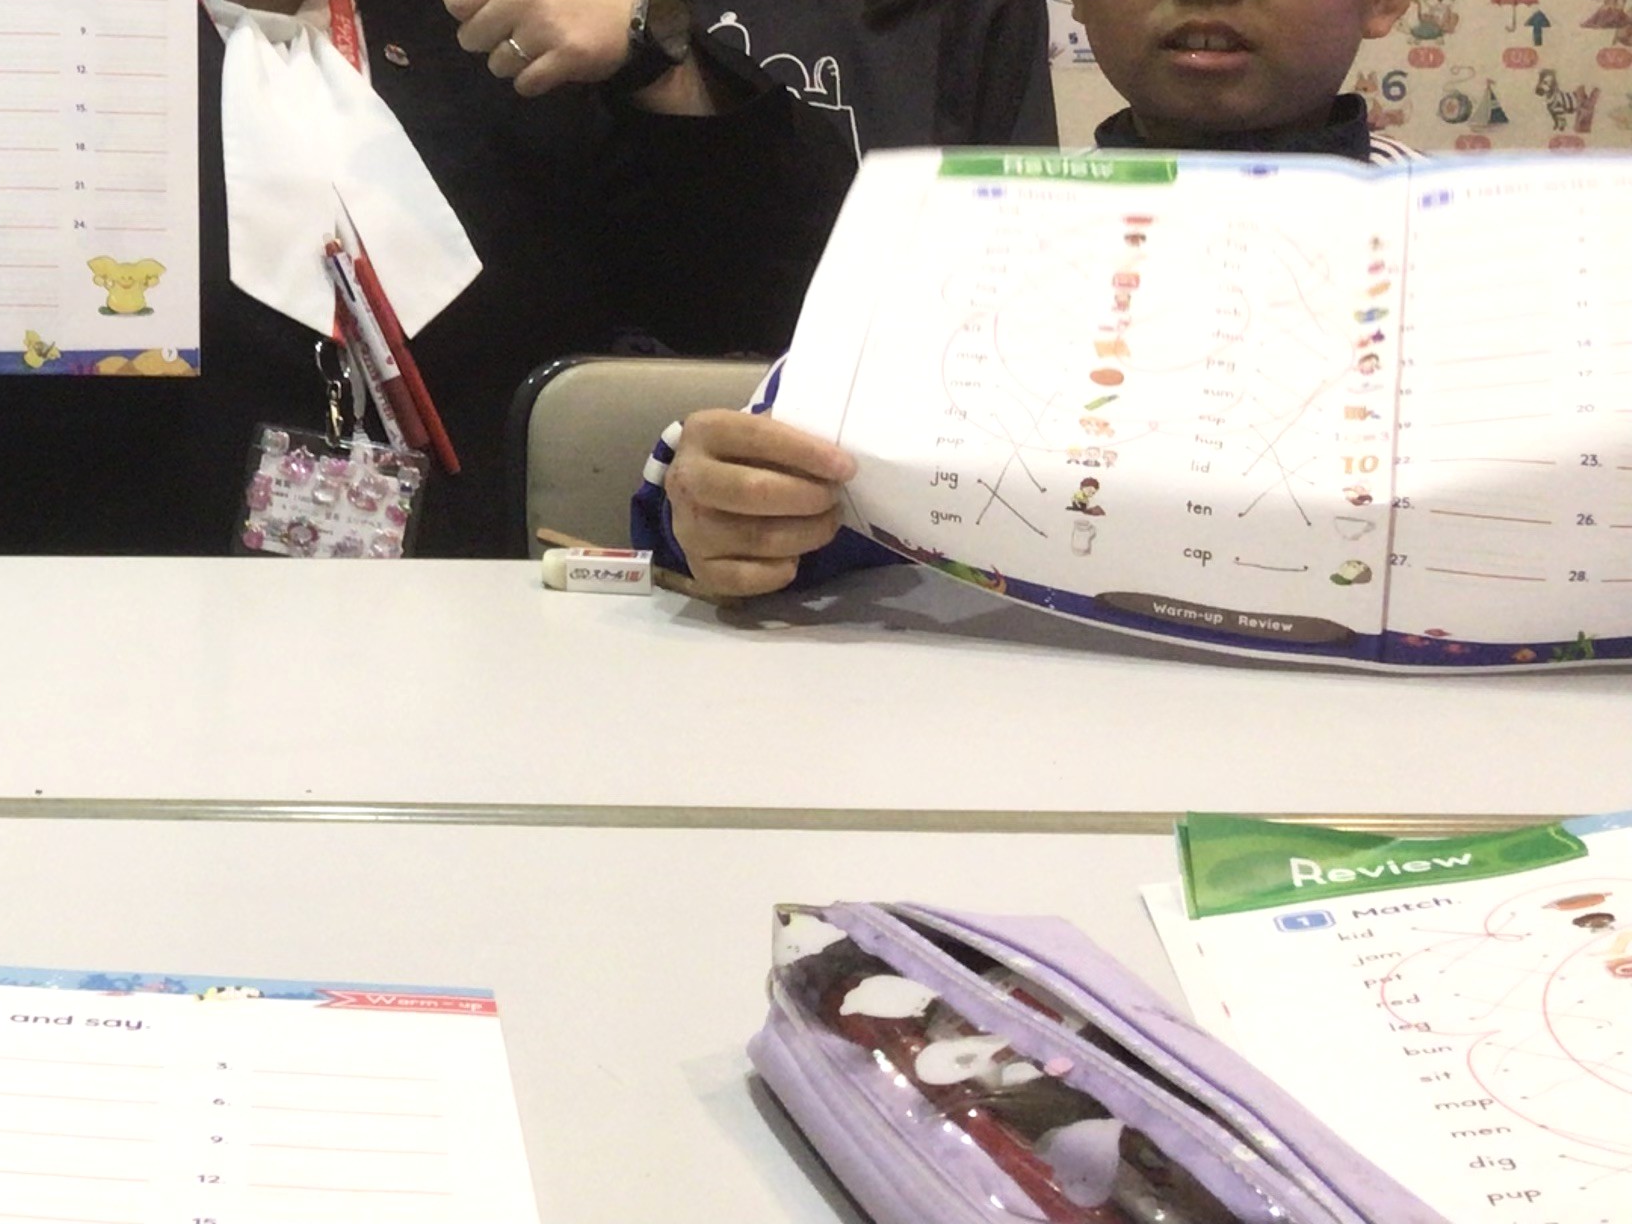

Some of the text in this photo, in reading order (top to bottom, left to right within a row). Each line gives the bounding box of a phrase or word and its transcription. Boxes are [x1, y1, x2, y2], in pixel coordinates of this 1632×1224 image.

[1381, 70, 1408, 102] 6
[1190, 460, 1211, 474] lid
[1580, 454, 1602, 467] 23.
[930, 467, 959, 489] jug
[1186, 499, 1213, 516] ten
[1391, 497, 1415, 509] 25.
[930, 509, 963, 526] gum
[1576, 514, 1597, 526] 26.
[1183, 545, 1213, 566] cap
[1390, 554, 1411, 567] 27.
[1568, 571, 1588, 583] 28.
[1153, 601, 1293, 633] Warm-up Review
[1289, 852, 1473, 888] Review
[1351, 896, 1462, 918] Match.
[1337, 928, 1374, 942] kid
[1351, 949, 1402, 967] jam
[1375, 993, 1421, 1007] red
[9, 1013, 73, 1025] and
[84, 1017, 152, 1031] say.
[1388, 1020, 1432, 1033] leg
[1403, 1043, 1453, 1057] bun
[1419, 1070, 1452, 1082] sit
[1434, 1097, 1494, 1112] map
[1450, 1125, 1512, 1139] men
[1468, 1154, 1517, 1172] dig
[1486, 1188, 1542, 1206] pup
